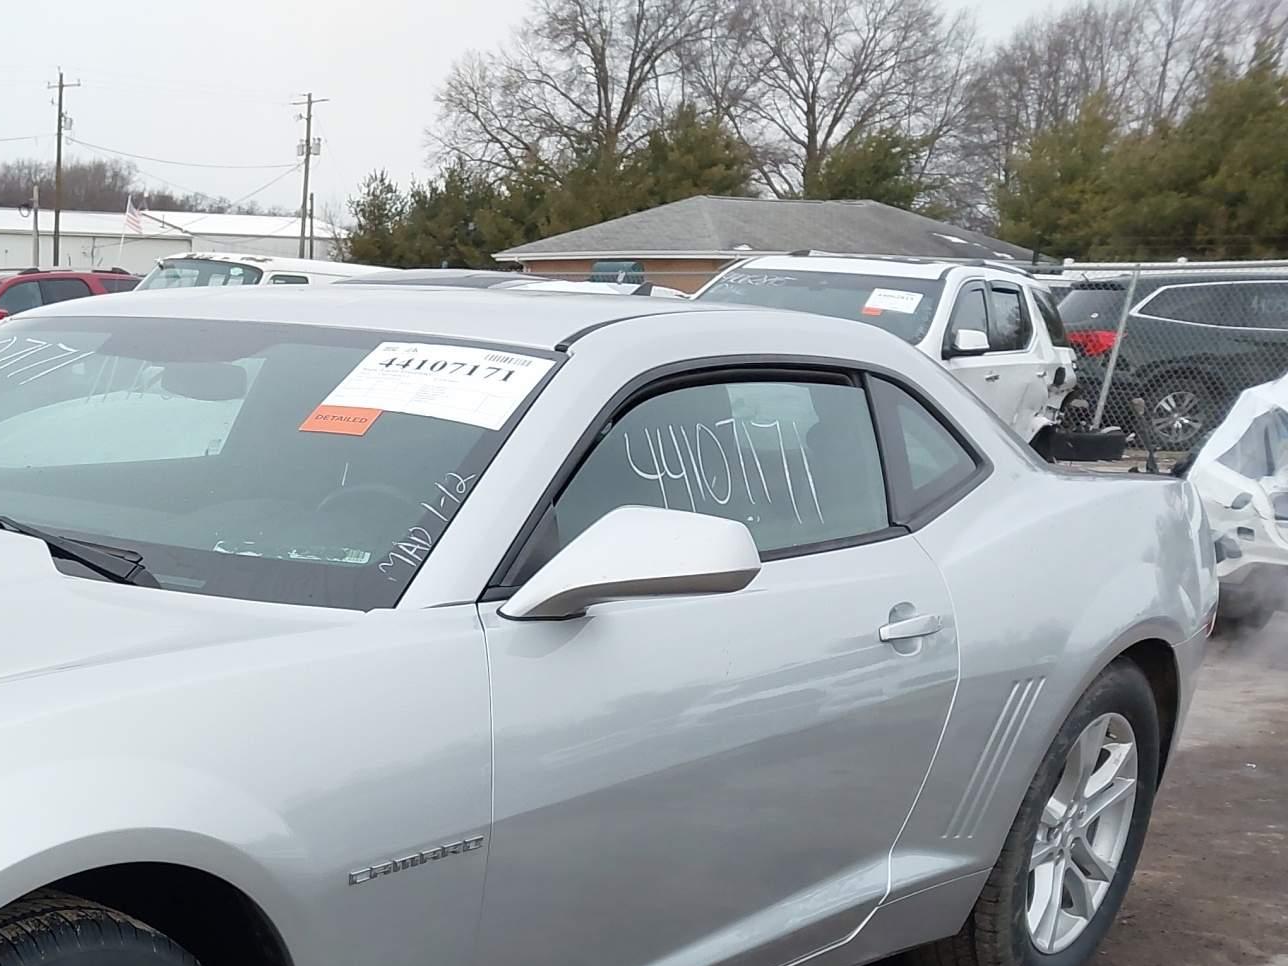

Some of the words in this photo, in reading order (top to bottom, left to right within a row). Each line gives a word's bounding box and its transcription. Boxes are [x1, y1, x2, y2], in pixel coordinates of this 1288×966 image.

[378, 356, 516, 383] 44107171
[314, 413, 369, 425] DETAILED
[624, 418, 825, 525] 44107171
[377, 526, 433, 573] MAD
[348, 835, 484, 885] CAMARO
